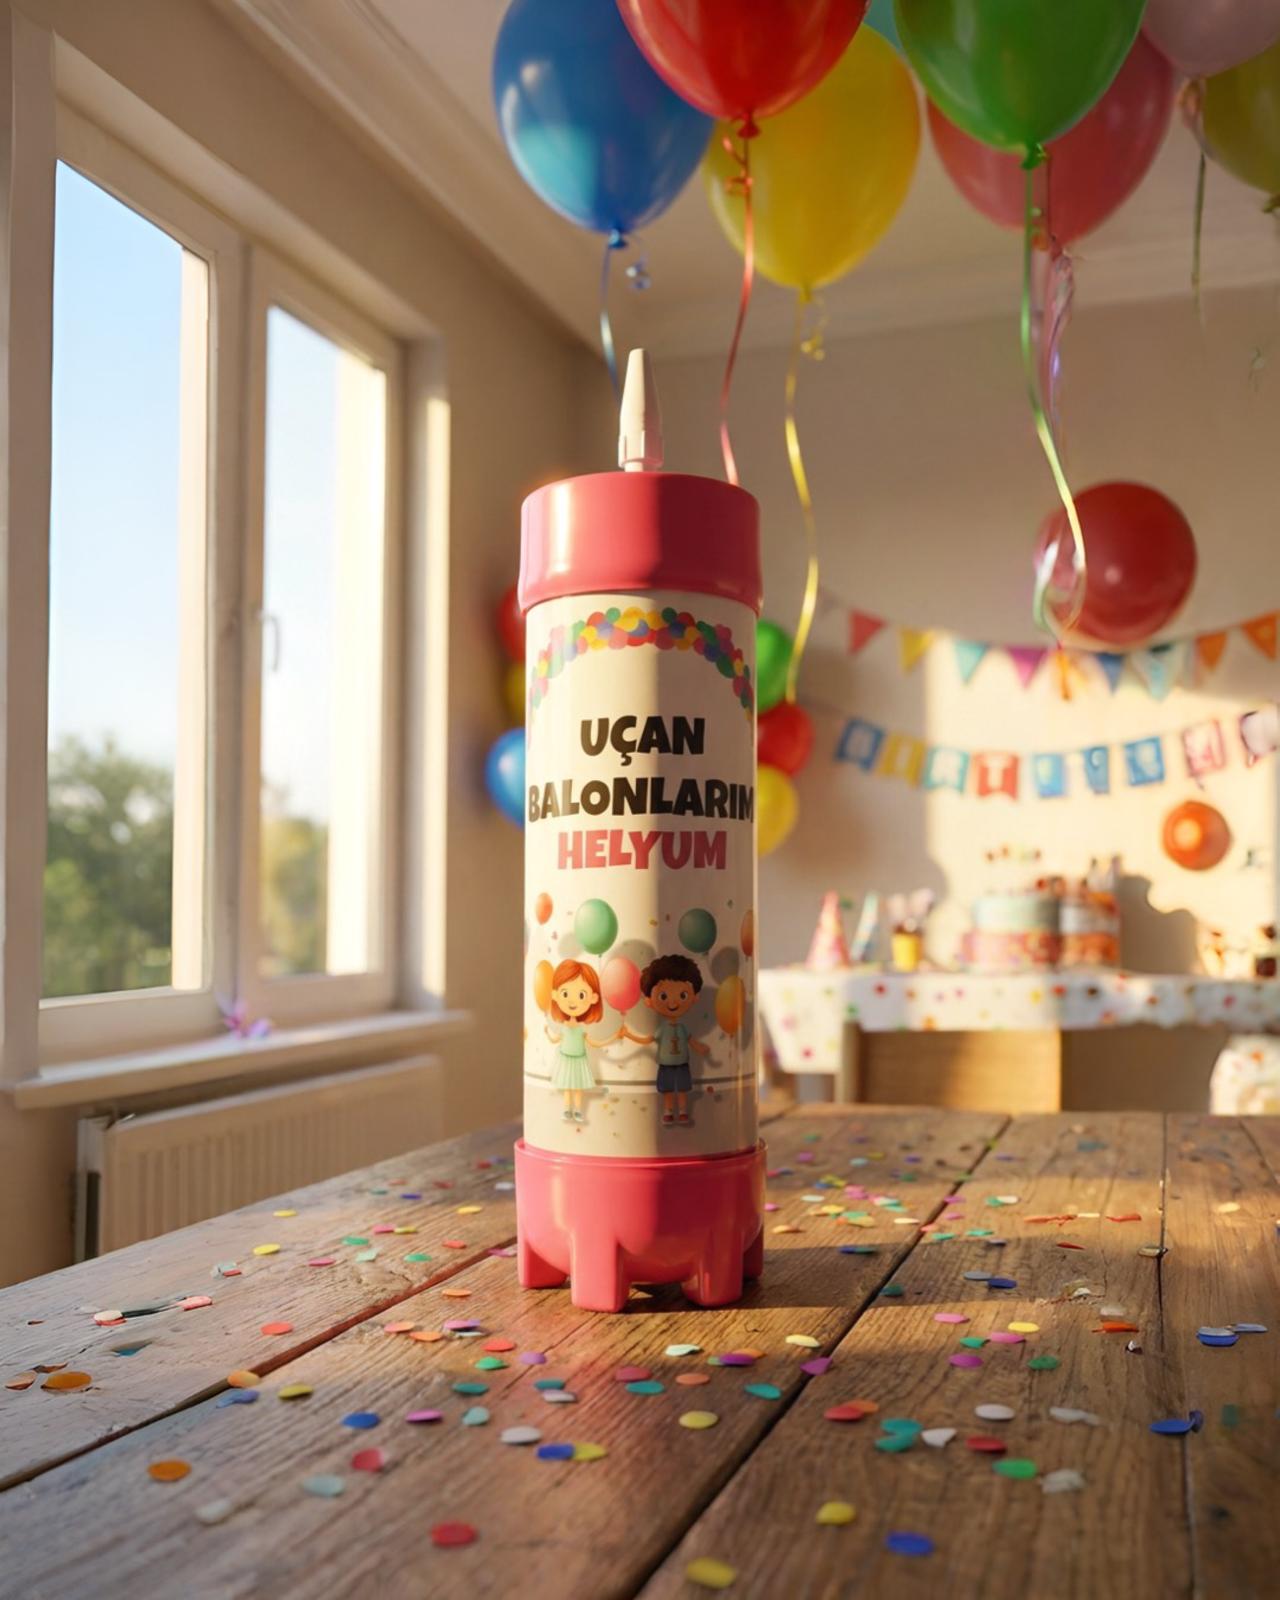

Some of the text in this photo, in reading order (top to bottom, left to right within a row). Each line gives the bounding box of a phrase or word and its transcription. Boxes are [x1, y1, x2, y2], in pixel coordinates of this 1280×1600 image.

[580, 715, 705, 766] UÇAN
[528, 777, 754, 823] BALONLARIM
[557, 829, 727, 870] HELYUM
